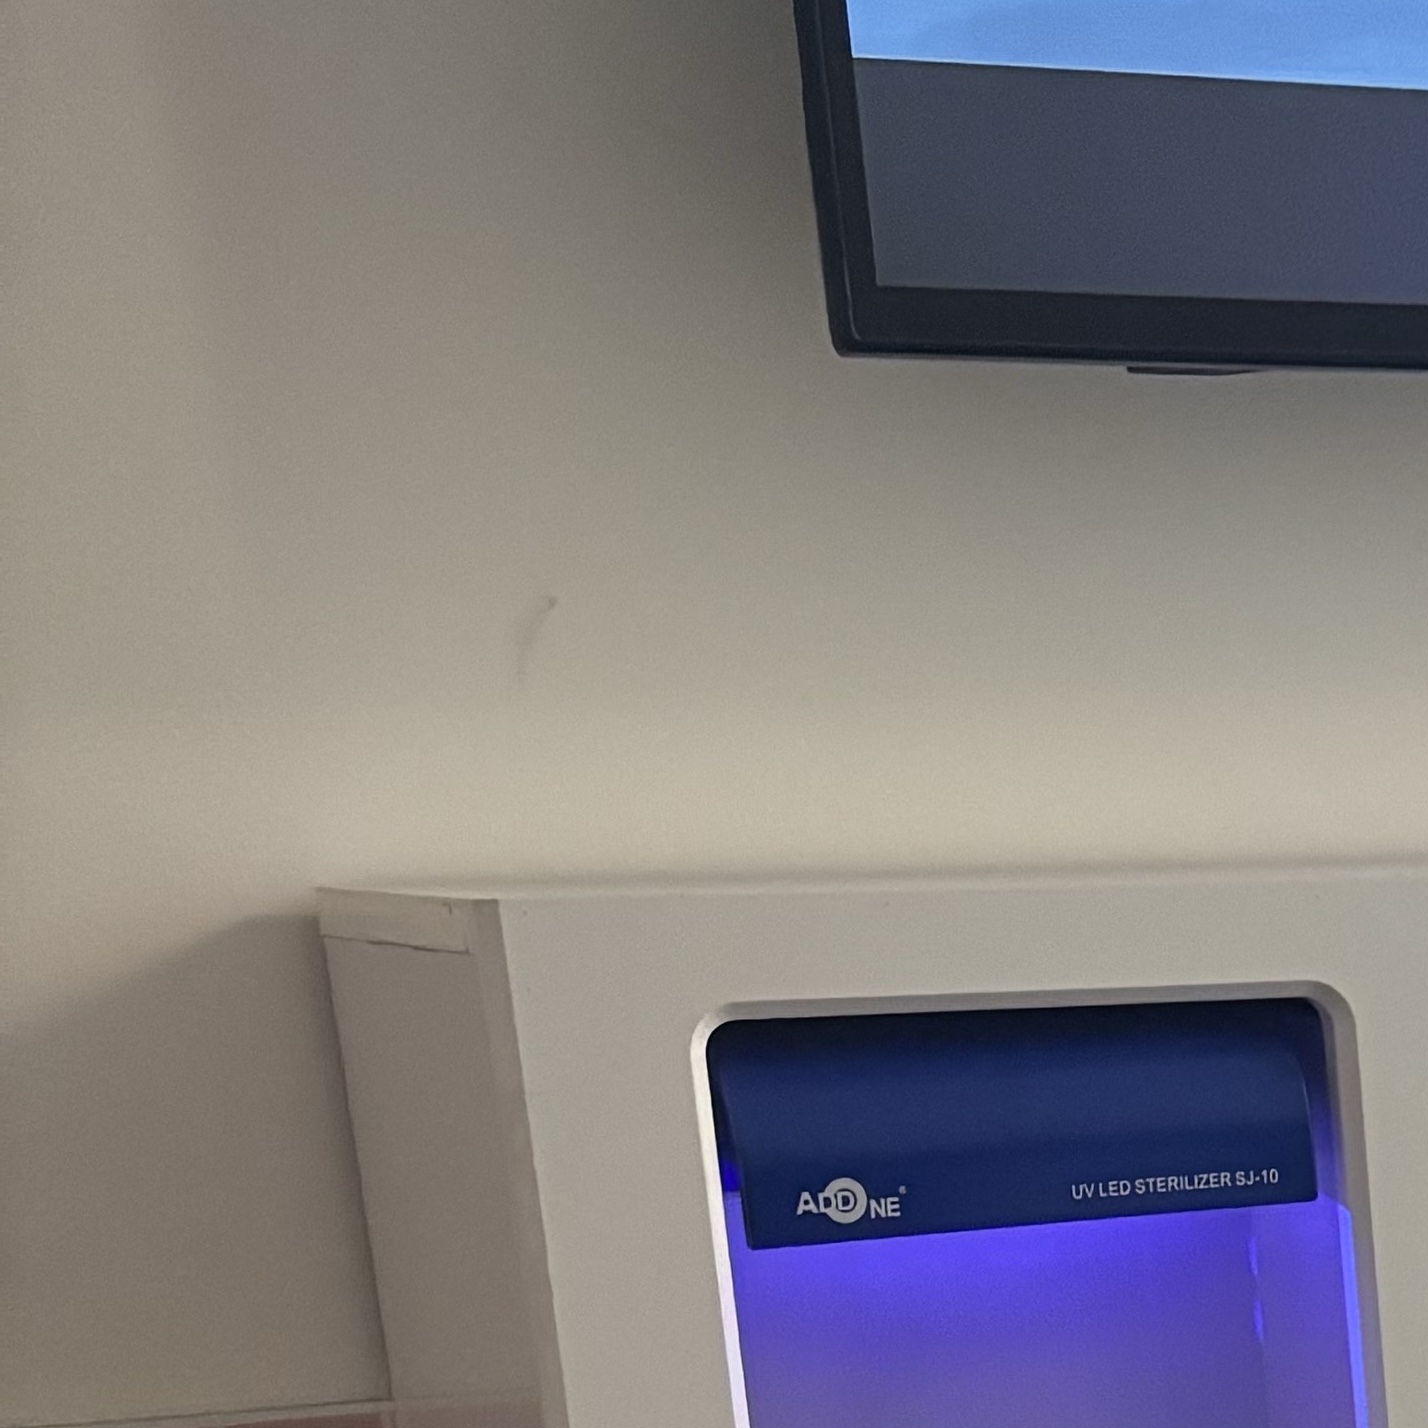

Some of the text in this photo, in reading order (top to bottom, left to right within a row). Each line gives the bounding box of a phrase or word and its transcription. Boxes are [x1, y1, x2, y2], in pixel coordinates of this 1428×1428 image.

[1071, 1167, 1279, 1200] UV LED STERILIZER SJ-10
